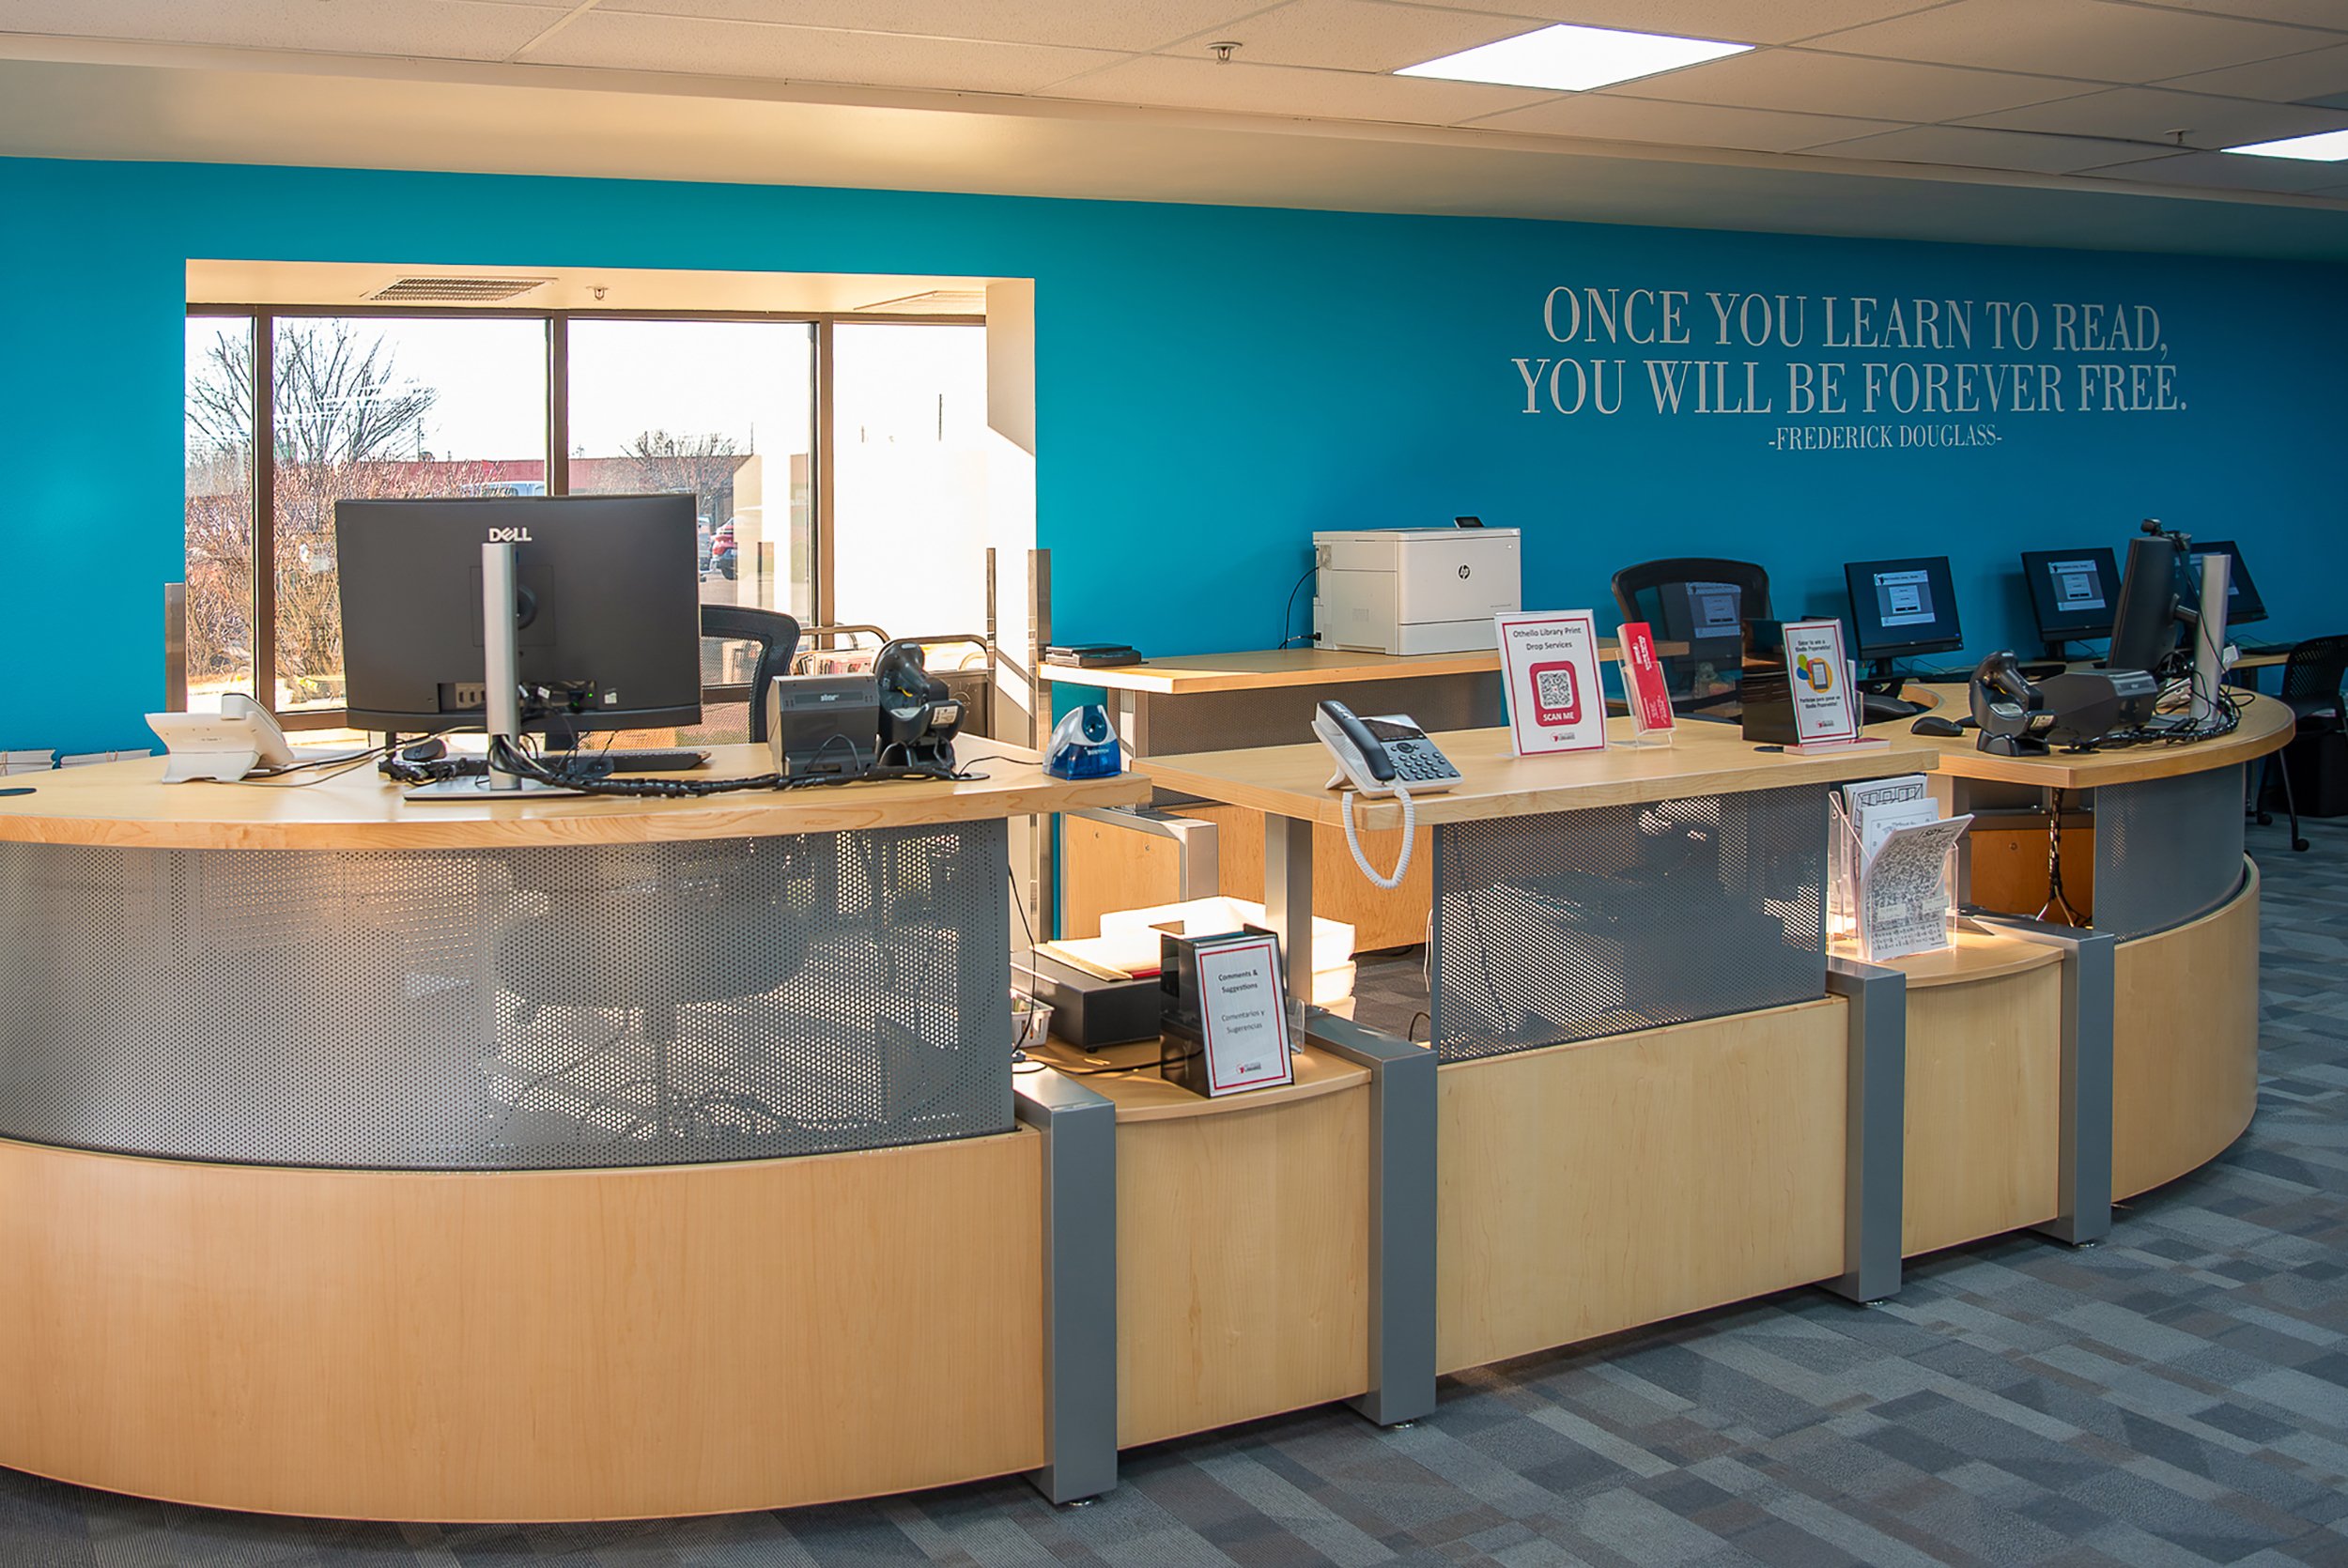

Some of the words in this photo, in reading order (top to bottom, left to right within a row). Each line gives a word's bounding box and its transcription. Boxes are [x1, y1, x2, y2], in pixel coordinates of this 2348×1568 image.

[1544, 285, 1690, 345] ONCE
[1706, 292, 1808, 347] YOU
[1822, 297, 1974, 350] LEARN
[1985, 300, 2040, 351] TO
[2052, 303, 2169, 361] READ,
[1510, 358, 1627, 415] YOU
[1643, 360, 1772, 414] WILL
[1786, 362, 1847, 414] BE
[1861, 362, 2066, 413] FOREVER
[2078, 364, 2187, 411] FREE.
[1769, 426, 1894, 451] -FREDERICK
[1899, 424, 2002, 448] DOUGLASS-
[488, 527, 533, 542] DELL
[1512, 629, 1539, 638] Othello
[1540, 627, 1564, 637] Library
[1565, 626, 1582, 635] Print
[1545, 640, 1573, 650] Services
[1542, 713, 1563, 722] SCAN
[1563, 711, 1575, 720] ME
[1217, 971, 1252, 982] Comments
[1221, 982, 1259, 993] Suggestions
[1221, 1010, 1260, 1022] Comentarios
[1226, 1022, 1263, 1034] Sugerencias
